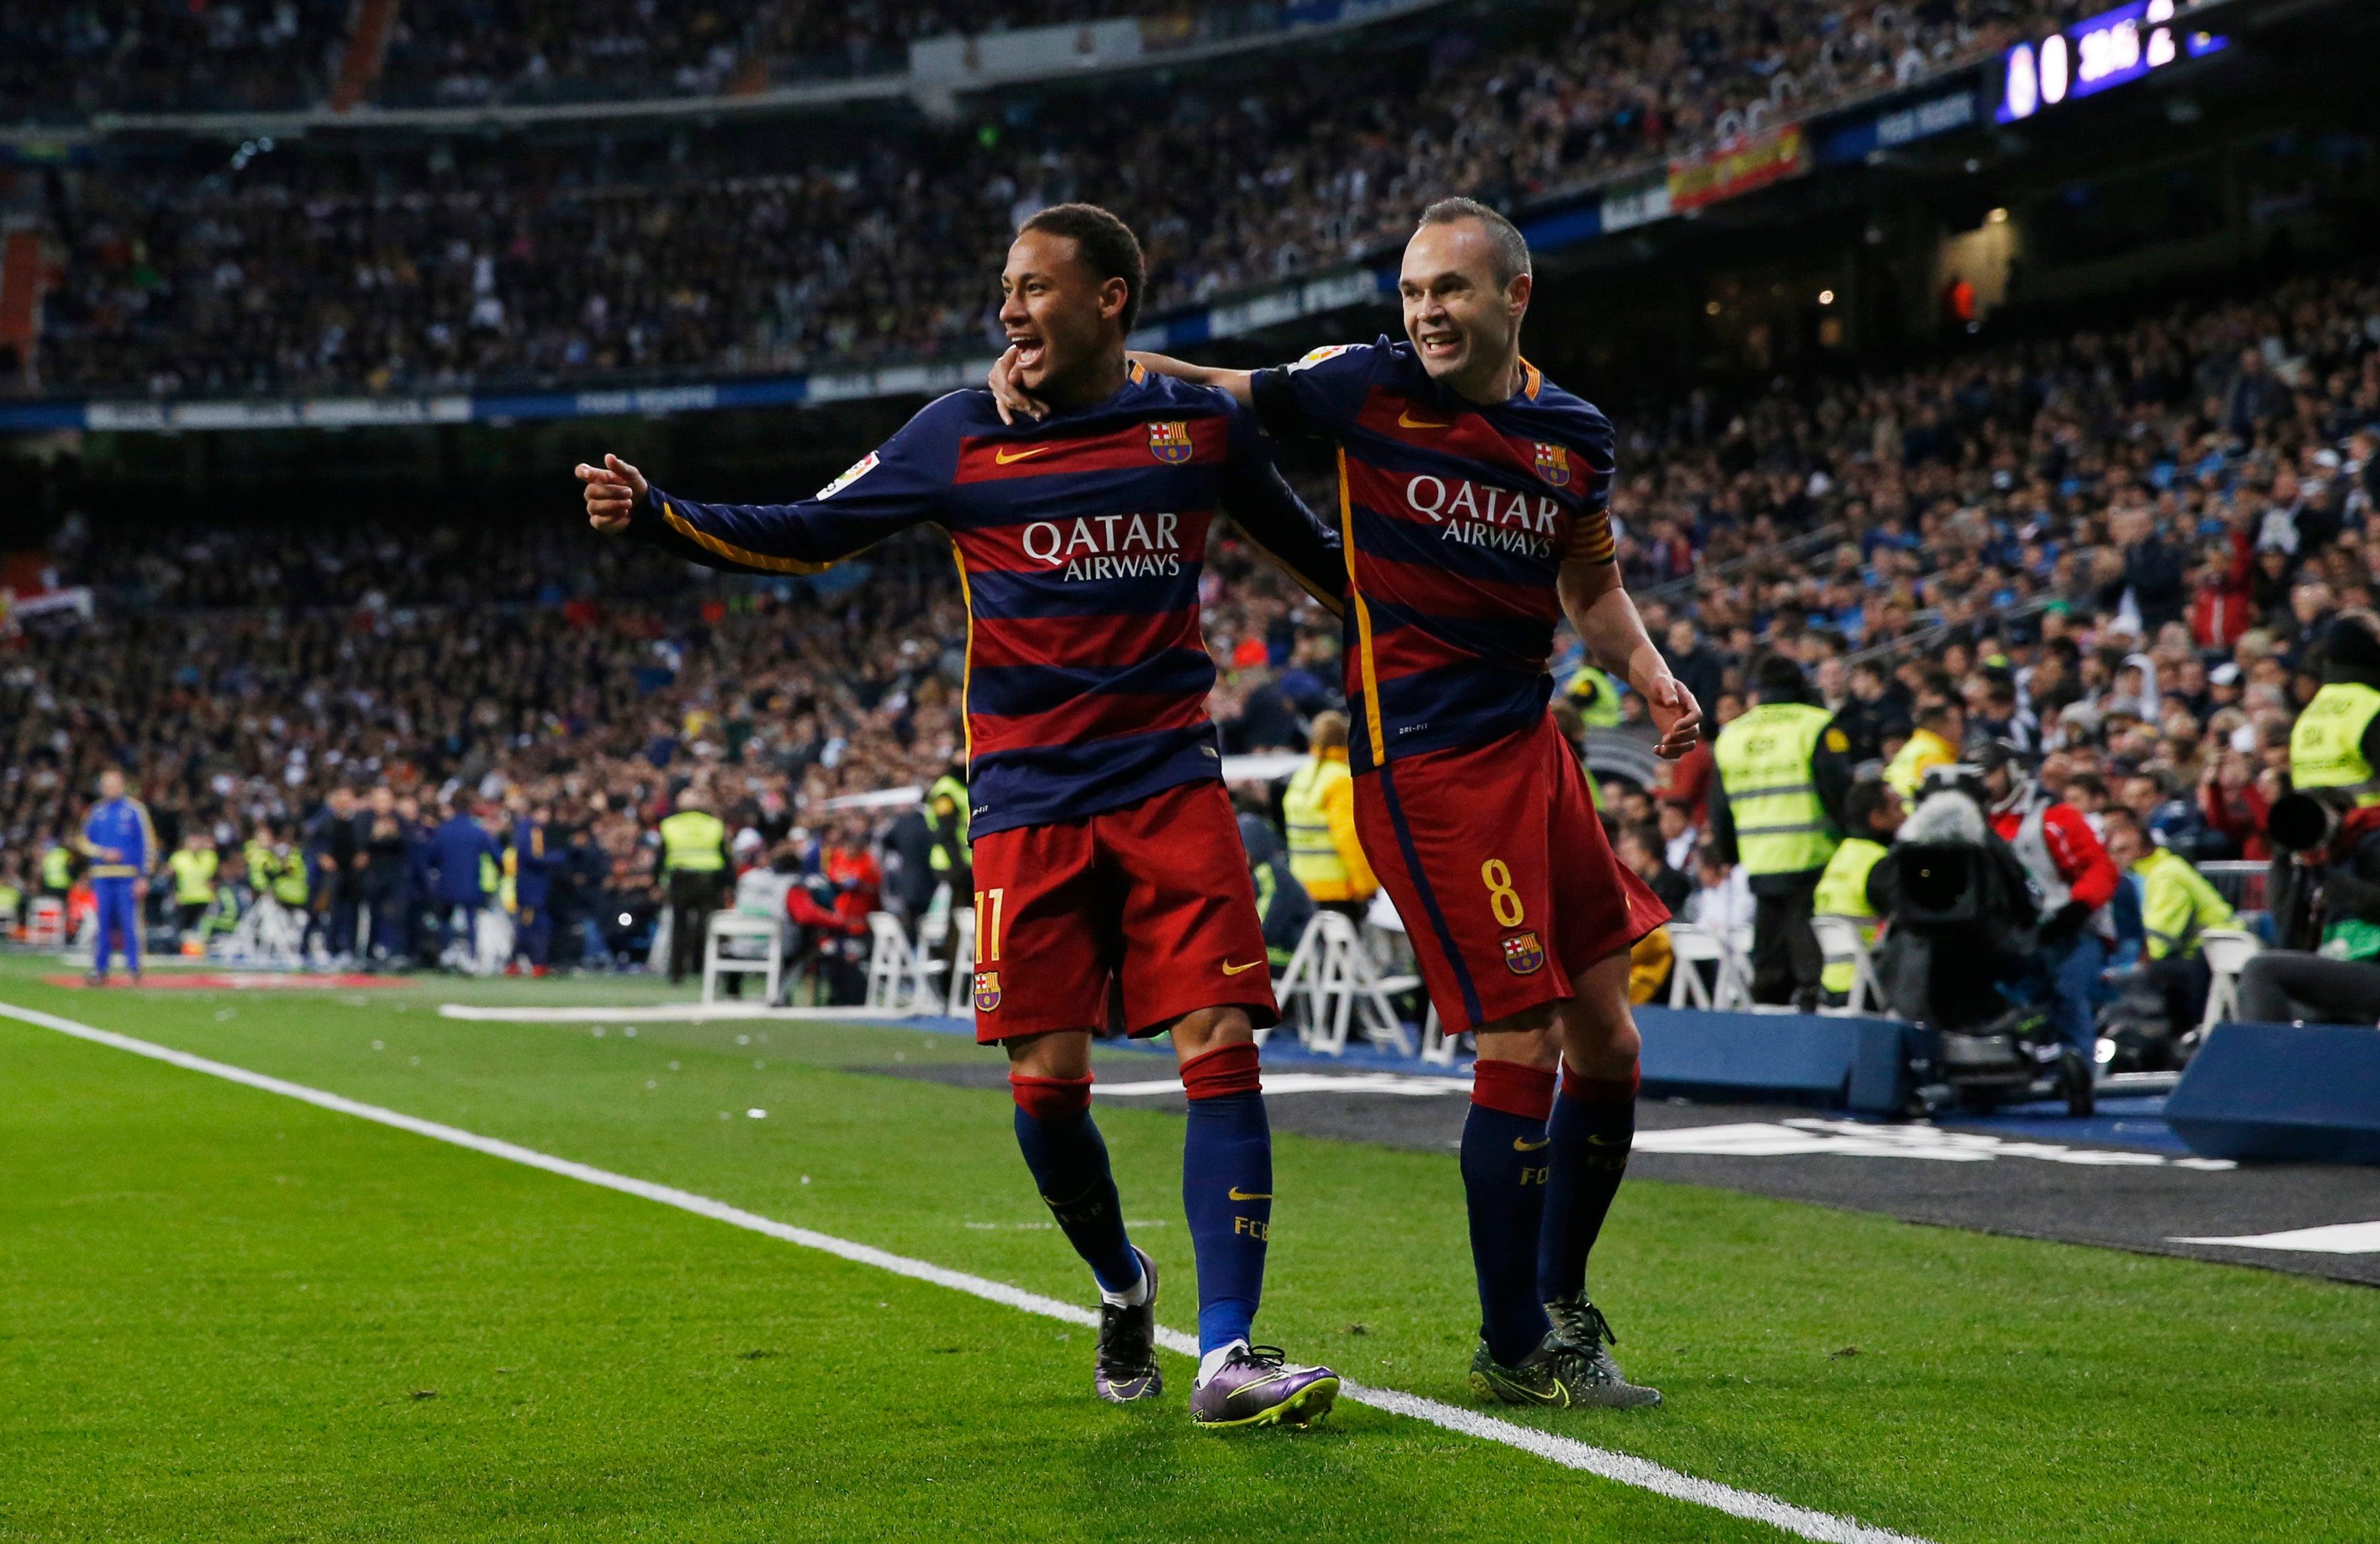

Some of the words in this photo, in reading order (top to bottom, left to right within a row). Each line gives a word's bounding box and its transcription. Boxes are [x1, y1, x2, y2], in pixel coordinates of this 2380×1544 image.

[1407, 475, 1559, 535] QATAR
[1022, 513, 1180, 566] QATAR
[1441, 519, 1556, 559] AIRWAYS
[1063, 553, 1180, 582] AIRWAYS
[1399, 723, 1428, 735] DRI-FIT
[1481, 859, 1524, 927] 8
[975, 888, 1004, 964] 11
[1520, 1166, 1550, 1186] FC
